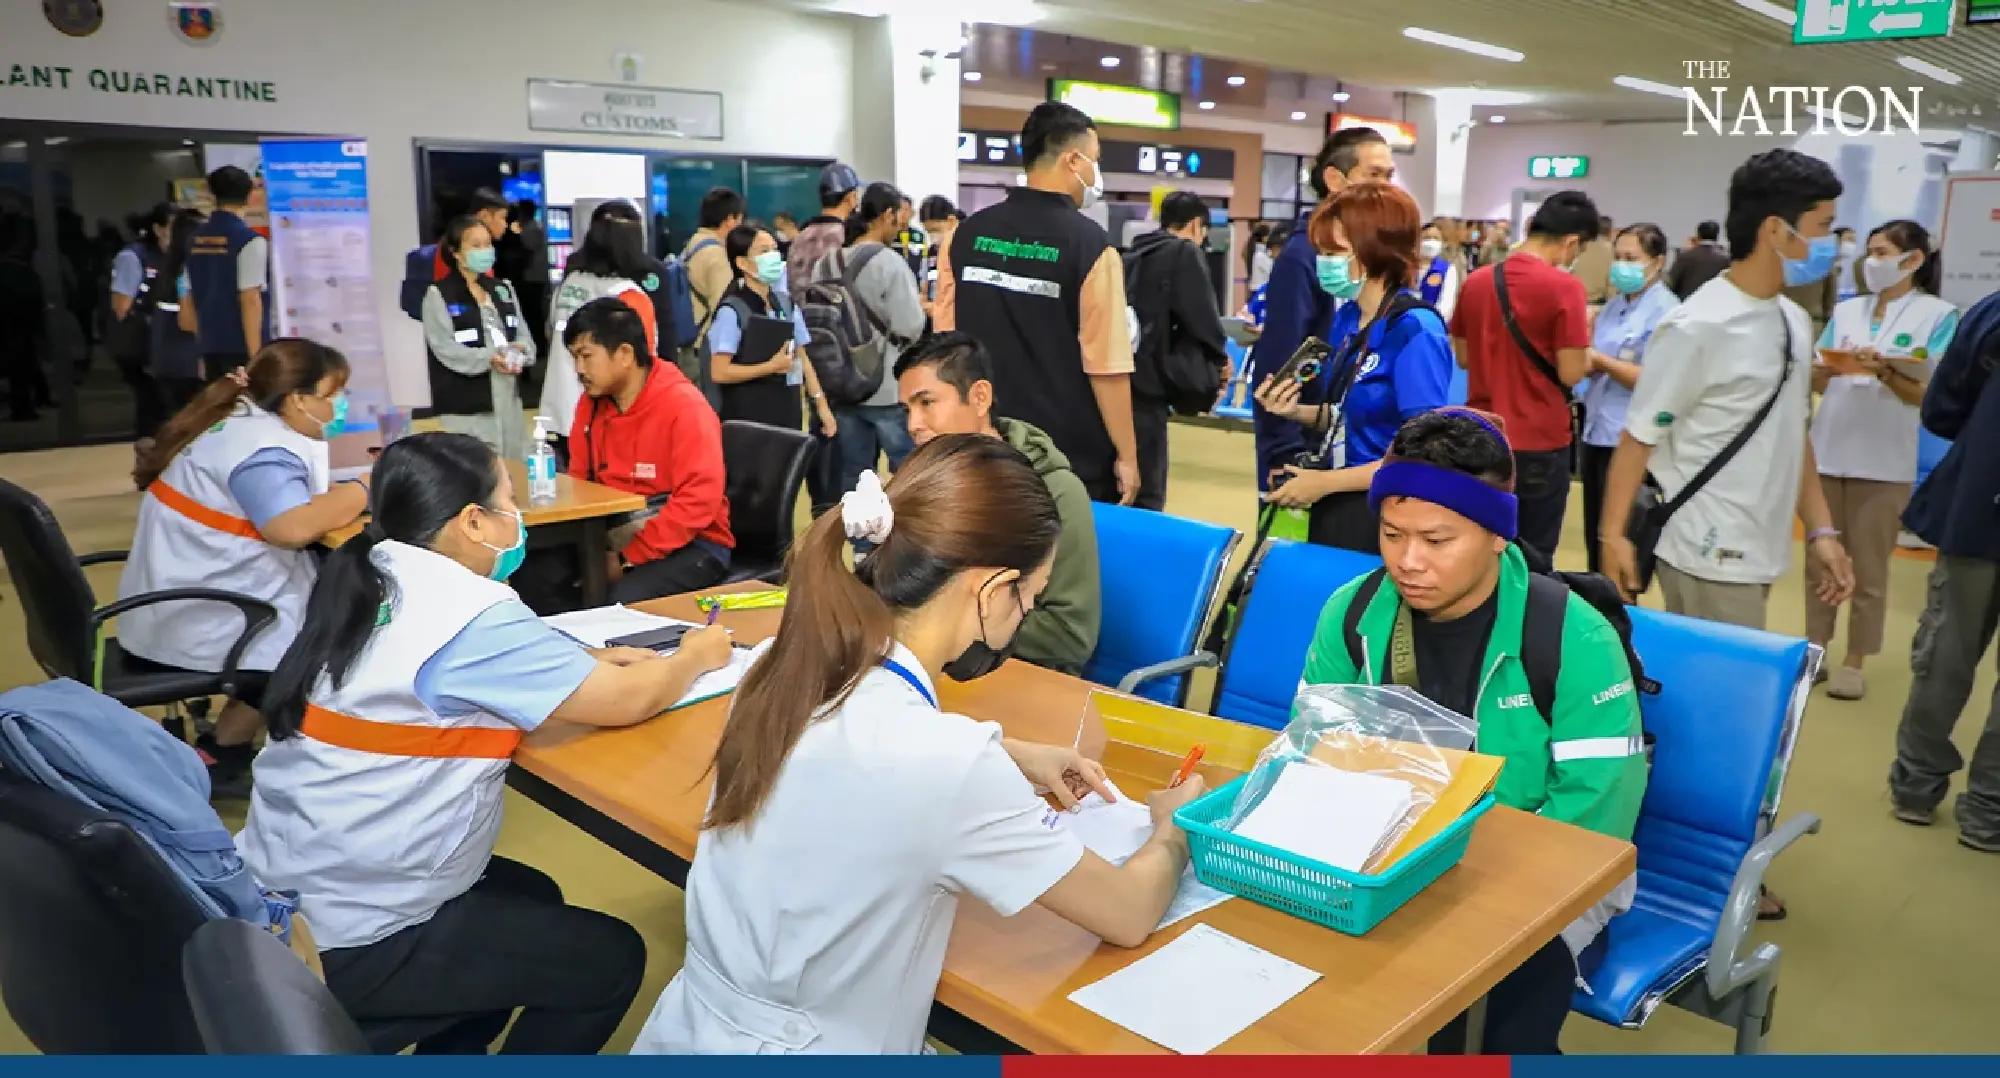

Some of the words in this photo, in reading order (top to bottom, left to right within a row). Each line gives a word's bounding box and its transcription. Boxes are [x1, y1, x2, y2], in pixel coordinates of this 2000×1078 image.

[0, 64, 73, 88] ANT
[88, 68, 278, 103] QUARANTINE
[580, 111, 678, 131] CUSTOMS
